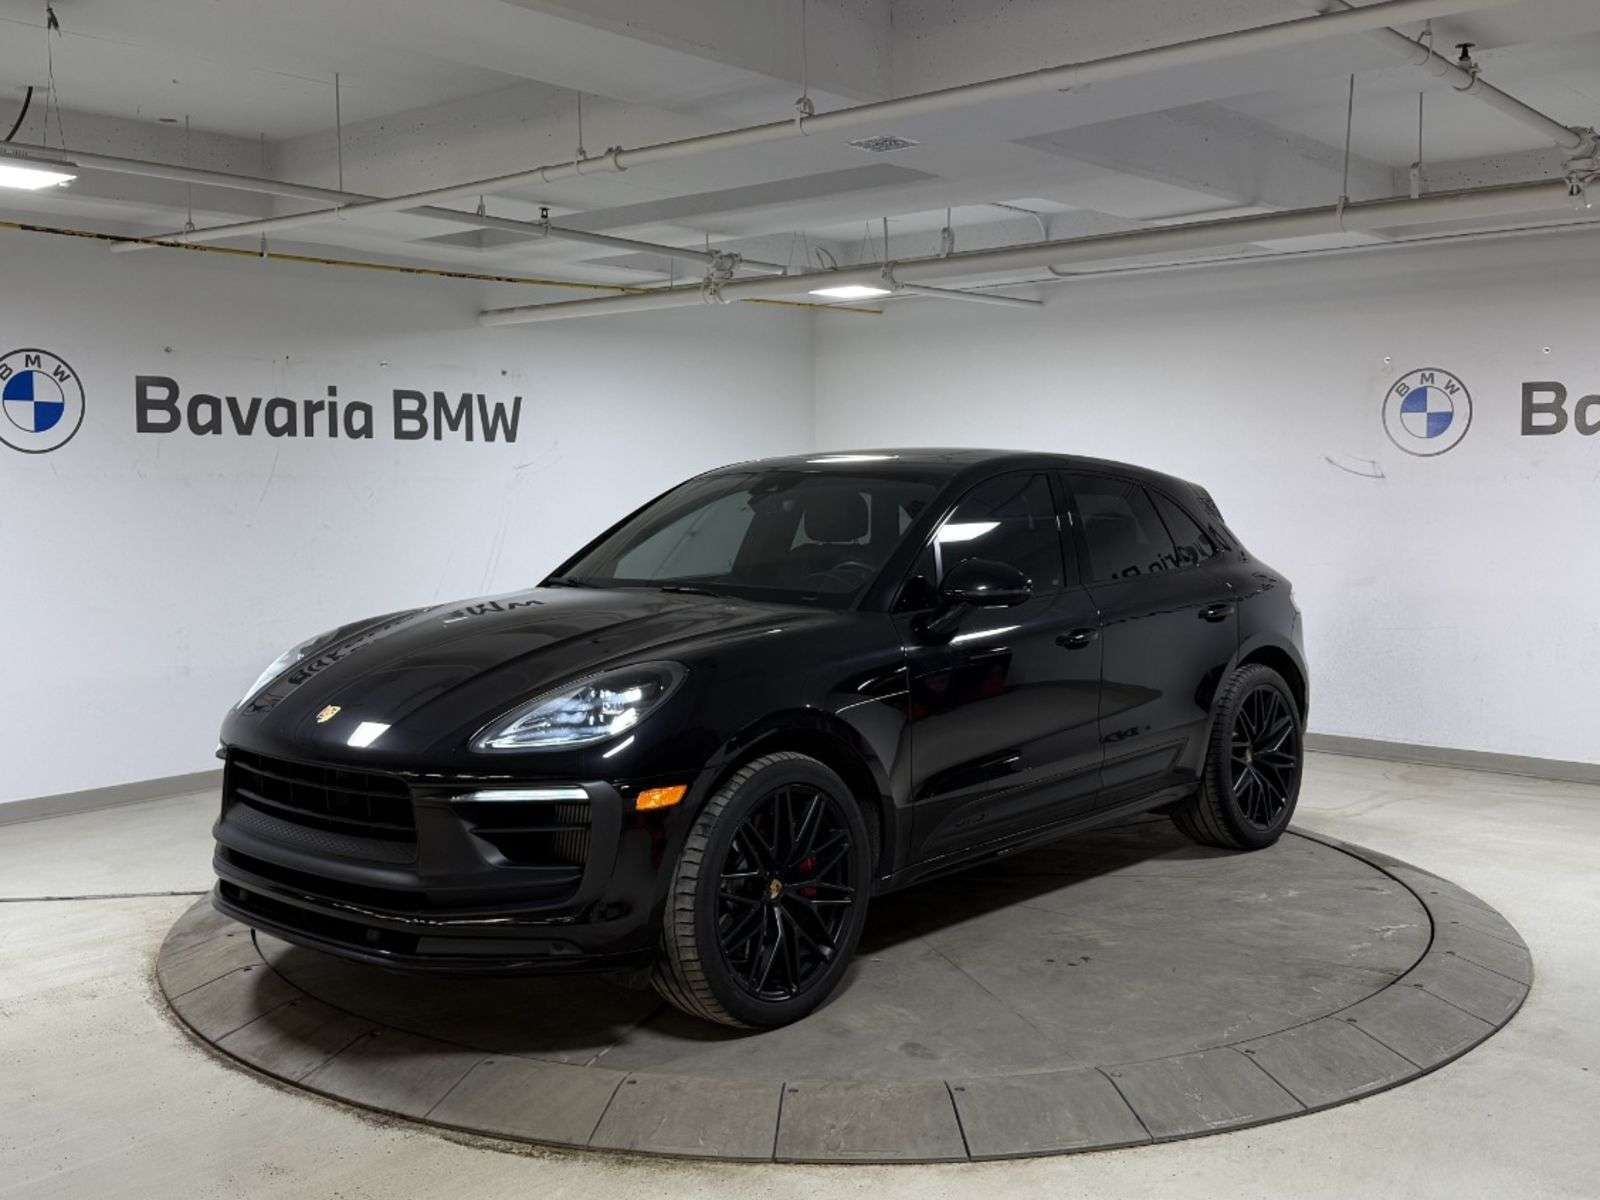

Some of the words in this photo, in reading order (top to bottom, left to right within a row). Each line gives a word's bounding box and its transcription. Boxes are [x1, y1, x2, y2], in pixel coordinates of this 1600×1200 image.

[1395, 372, 1461, 398] BMW
[135, 375, 374, 439] Bavaria
[393, 389, 522, 443] BMW
